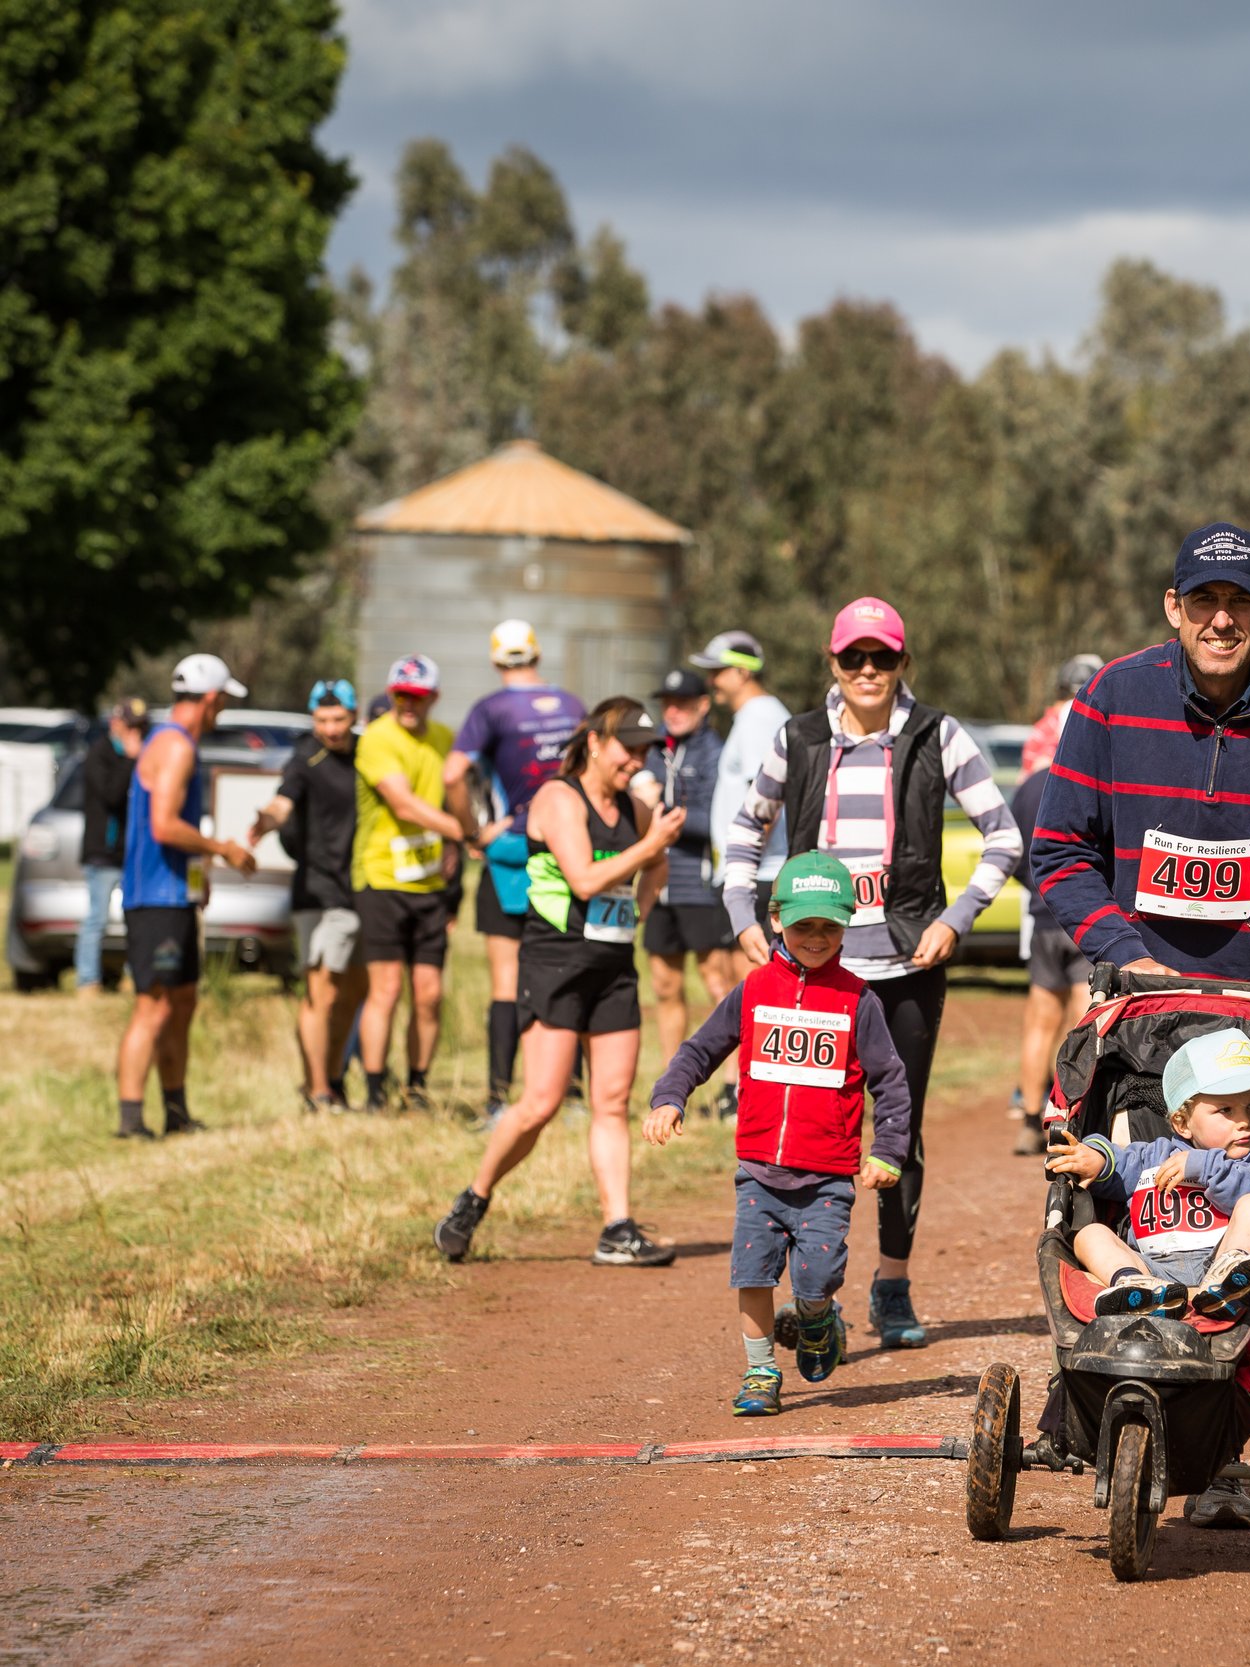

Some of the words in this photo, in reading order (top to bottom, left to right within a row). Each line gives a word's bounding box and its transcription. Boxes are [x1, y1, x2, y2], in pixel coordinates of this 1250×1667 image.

[1154, 837, 1173, 849] Run
[1177, 842, 1193, 853] For
[1197, 845, 1247, 855] Resilience
[1151, 855, 1242, 899] 499
[763, 1012, 777, 1020] Run
[781, 1013, 793, 1022] For
[798, 1016, 841, 1027] Resilience
[761, 1026, 837, 1068] 496
[1139, 1187, 1214, 1232] 498
